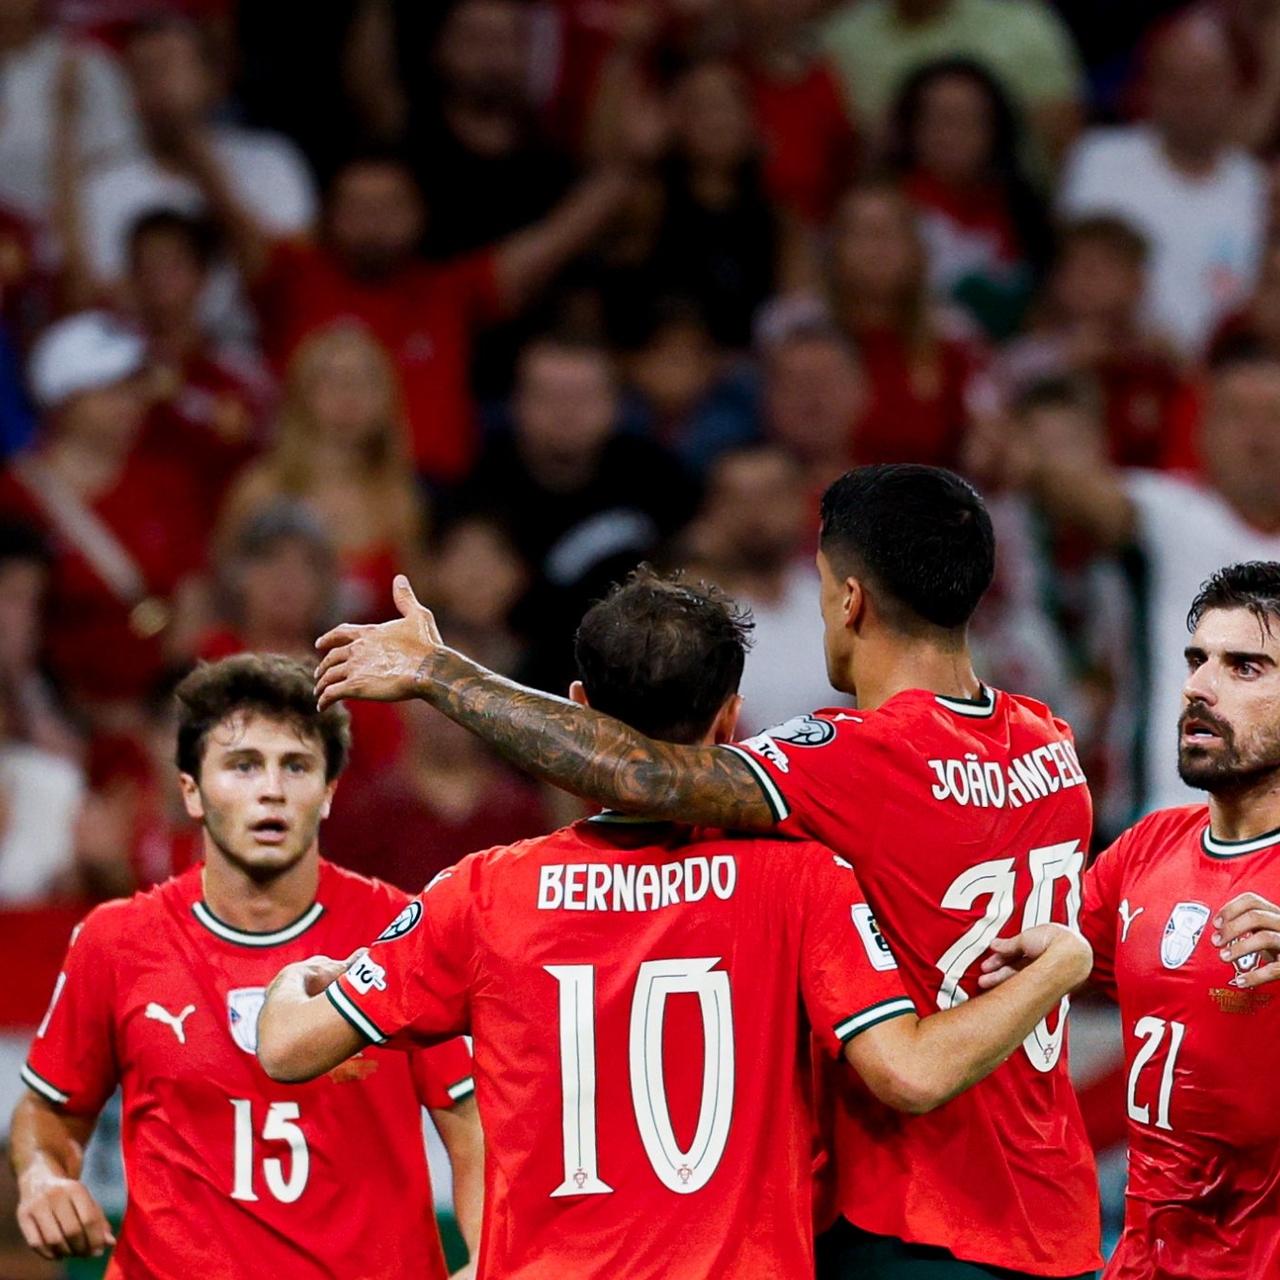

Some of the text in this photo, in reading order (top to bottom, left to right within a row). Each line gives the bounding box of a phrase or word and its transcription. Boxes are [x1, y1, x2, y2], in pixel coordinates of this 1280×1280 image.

[927, 740, 1088, 809] JOÃO ANCEL
[537, 855, 737, 912] BERNARDO
[542, 957, 735, 1197] 10
[1126, 1015, 1186, 1131] 21
[229, 1098, 310, 1204] 15
